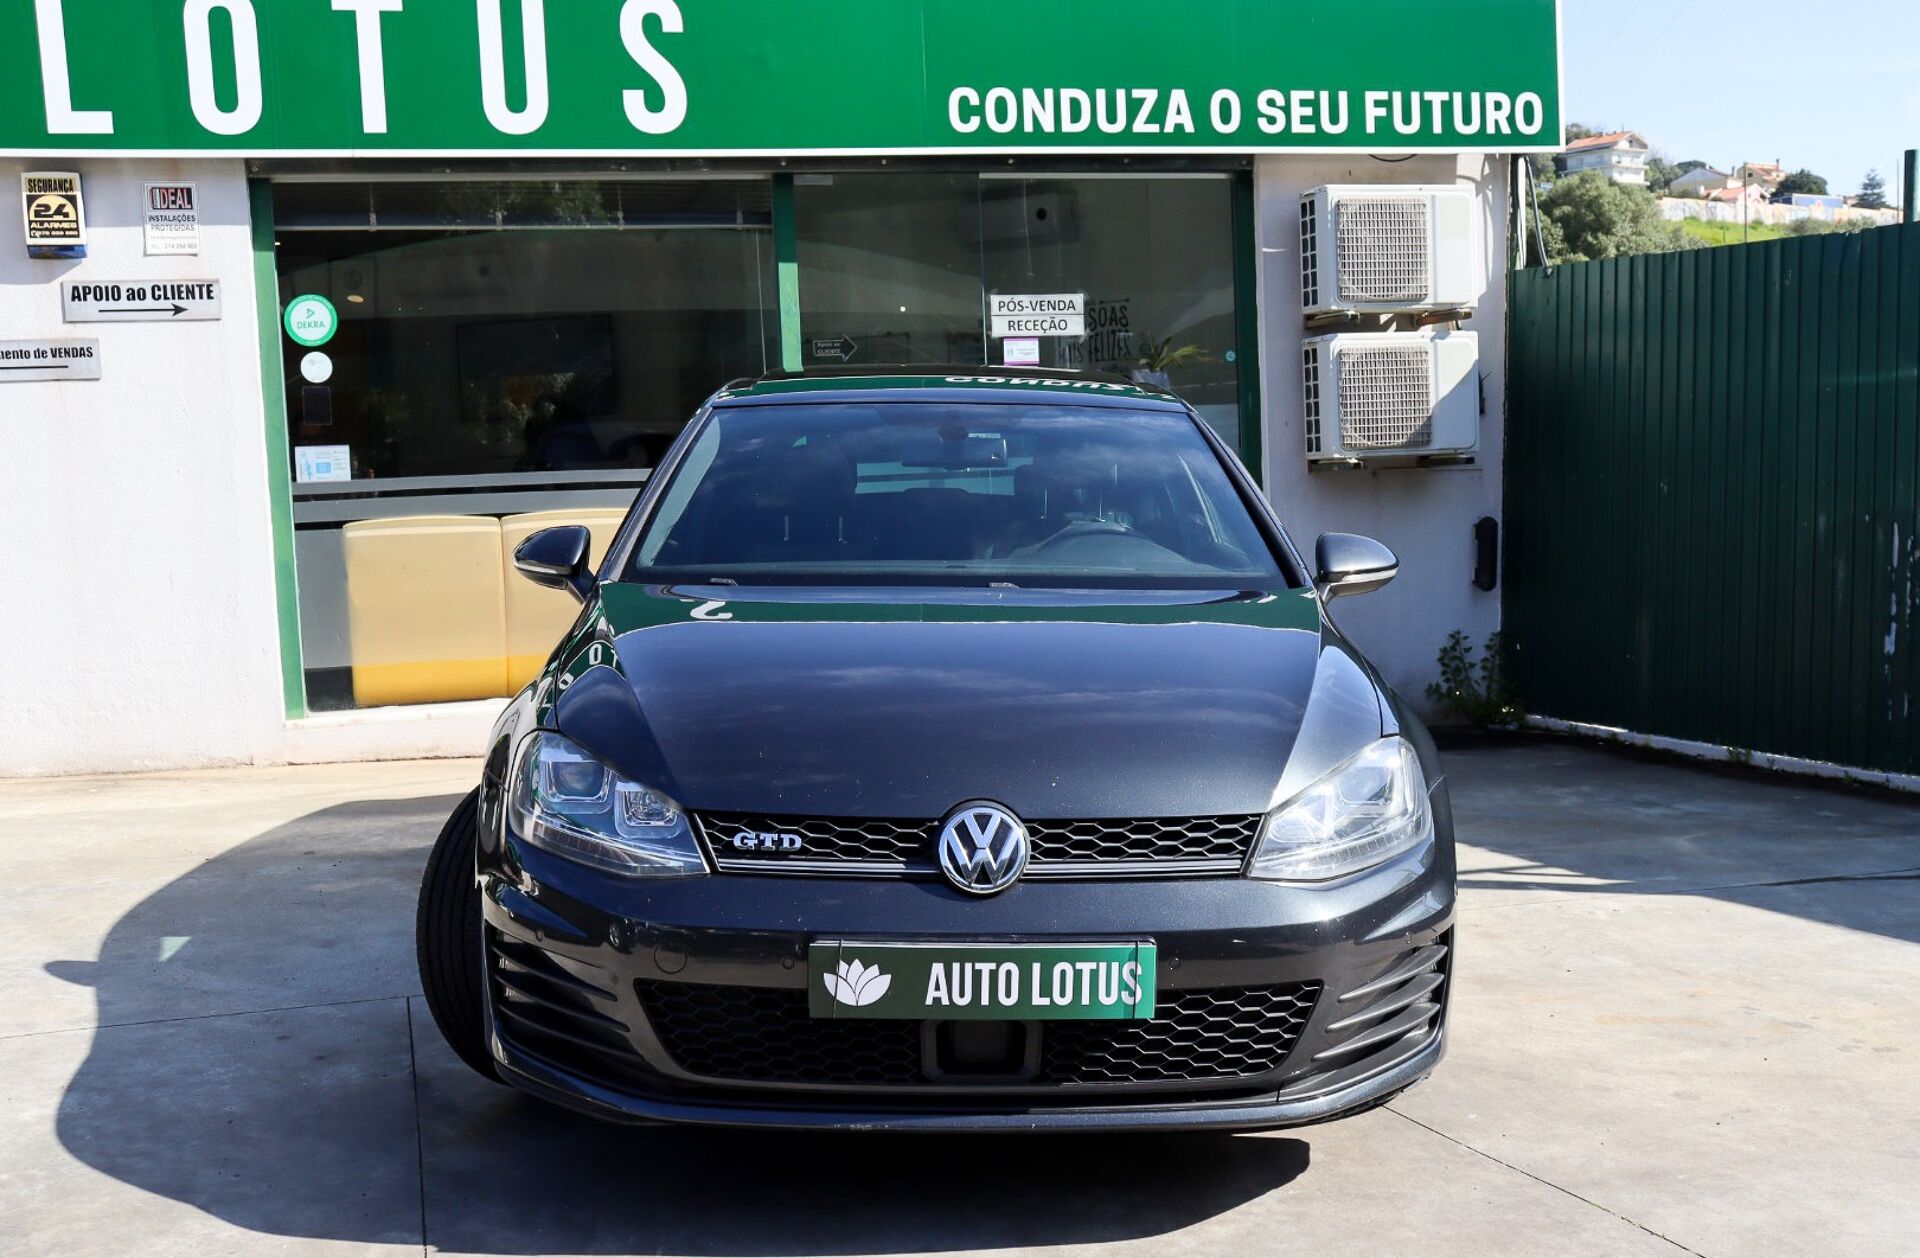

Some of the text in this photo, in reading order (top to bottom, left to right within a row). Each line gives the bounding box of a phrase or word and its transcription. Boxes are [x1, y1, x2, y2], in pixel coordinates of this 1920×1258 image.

[35, 0, 688, 135] LOTUS
[948, 86, 1543, 135] CONDUZA O SEU FUTURO
[34, 203, 70, 218] 24
[70, 283, 214, 302] APOIO ao CLIENTE
[998, 297, 1076, 312] PÓS-VENDA
[297, 321, 325, 329] DEKRA
[1008, 316, 1068, 334] RECEÇÃO
[33, 347, 48, 359] de
[50, 347, 93, 359] VENDAS
[733, 832, 802, 850] GTD
[926, 961, 1143, 1006] AUTO LOTUS
